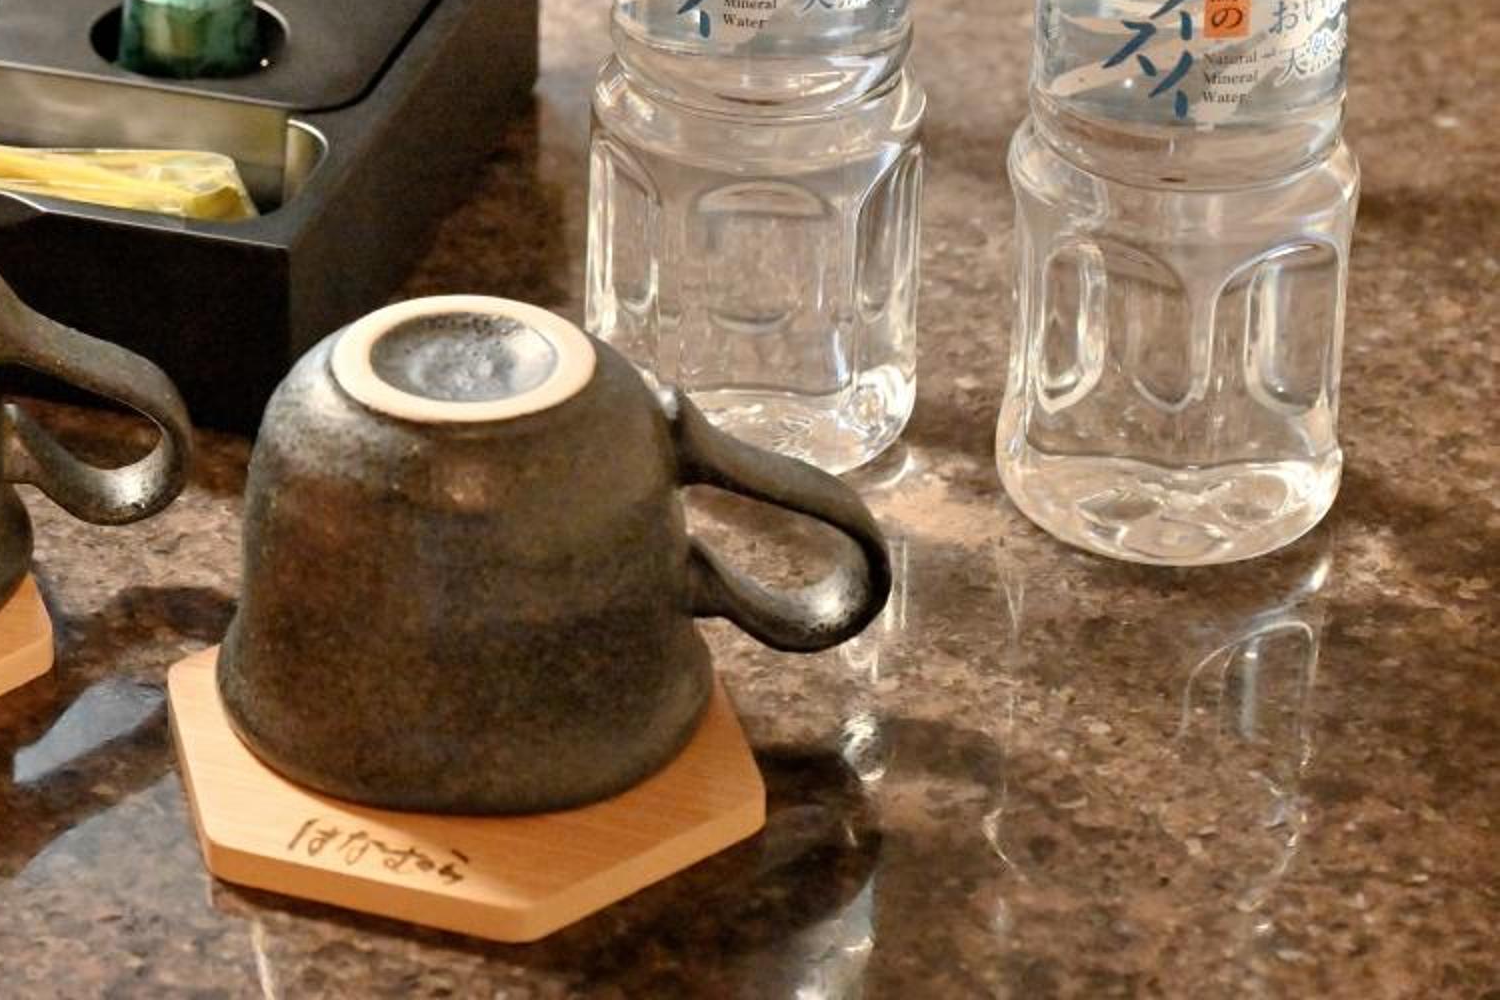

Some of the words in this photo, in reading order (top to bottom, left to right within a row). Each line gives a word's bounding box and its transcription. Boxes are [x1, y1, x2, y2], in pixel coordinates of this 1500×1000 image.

[723, 13, 768, 29] Water
[1203, 49, 1257, 65] Natural
[1203, 69, 1258, 85] Mineral
[1203, 91, 1252, 105] Water
